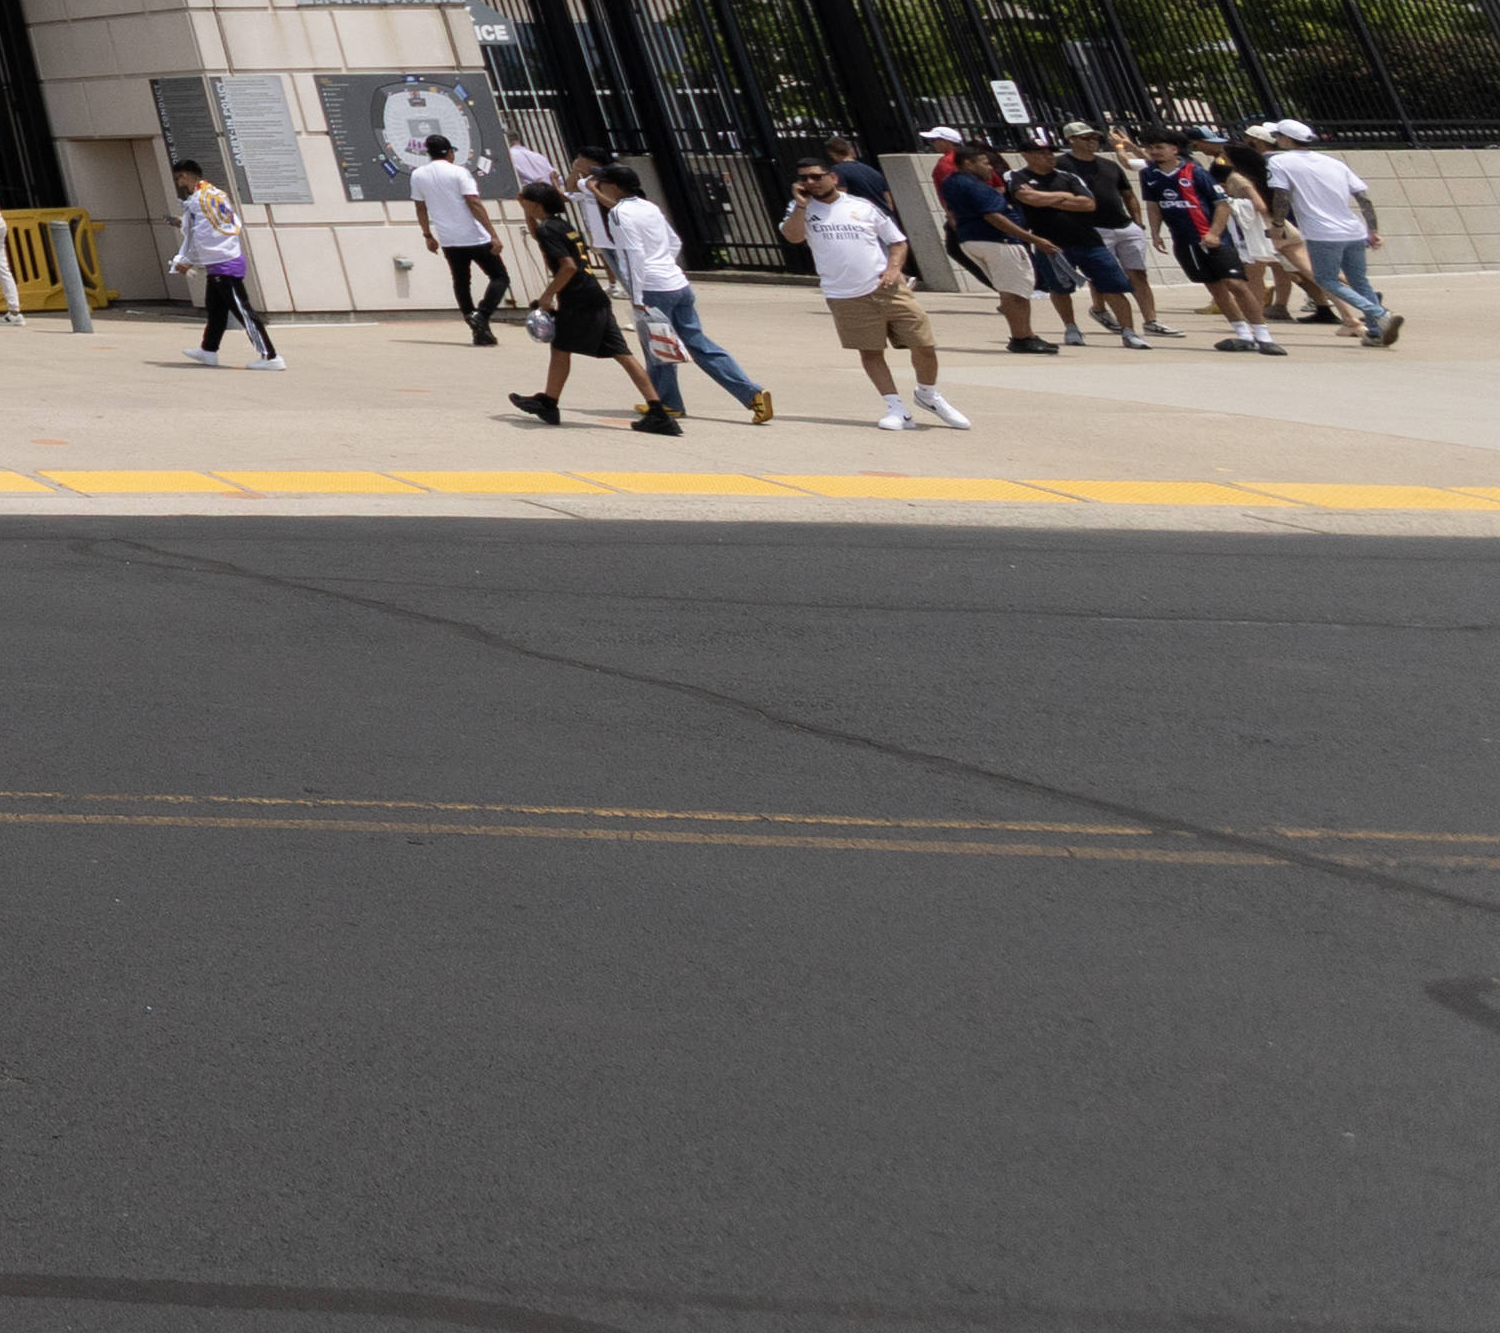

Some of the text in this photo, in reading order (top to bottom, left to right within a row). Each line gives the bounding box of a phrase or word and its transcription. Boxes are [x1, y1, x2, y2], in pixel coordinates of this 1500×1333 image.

[473, 24, 509, 41] ICE
[1159, 200, 1197, 209] OPEL
[812, 222, 866, 233] Emirates
